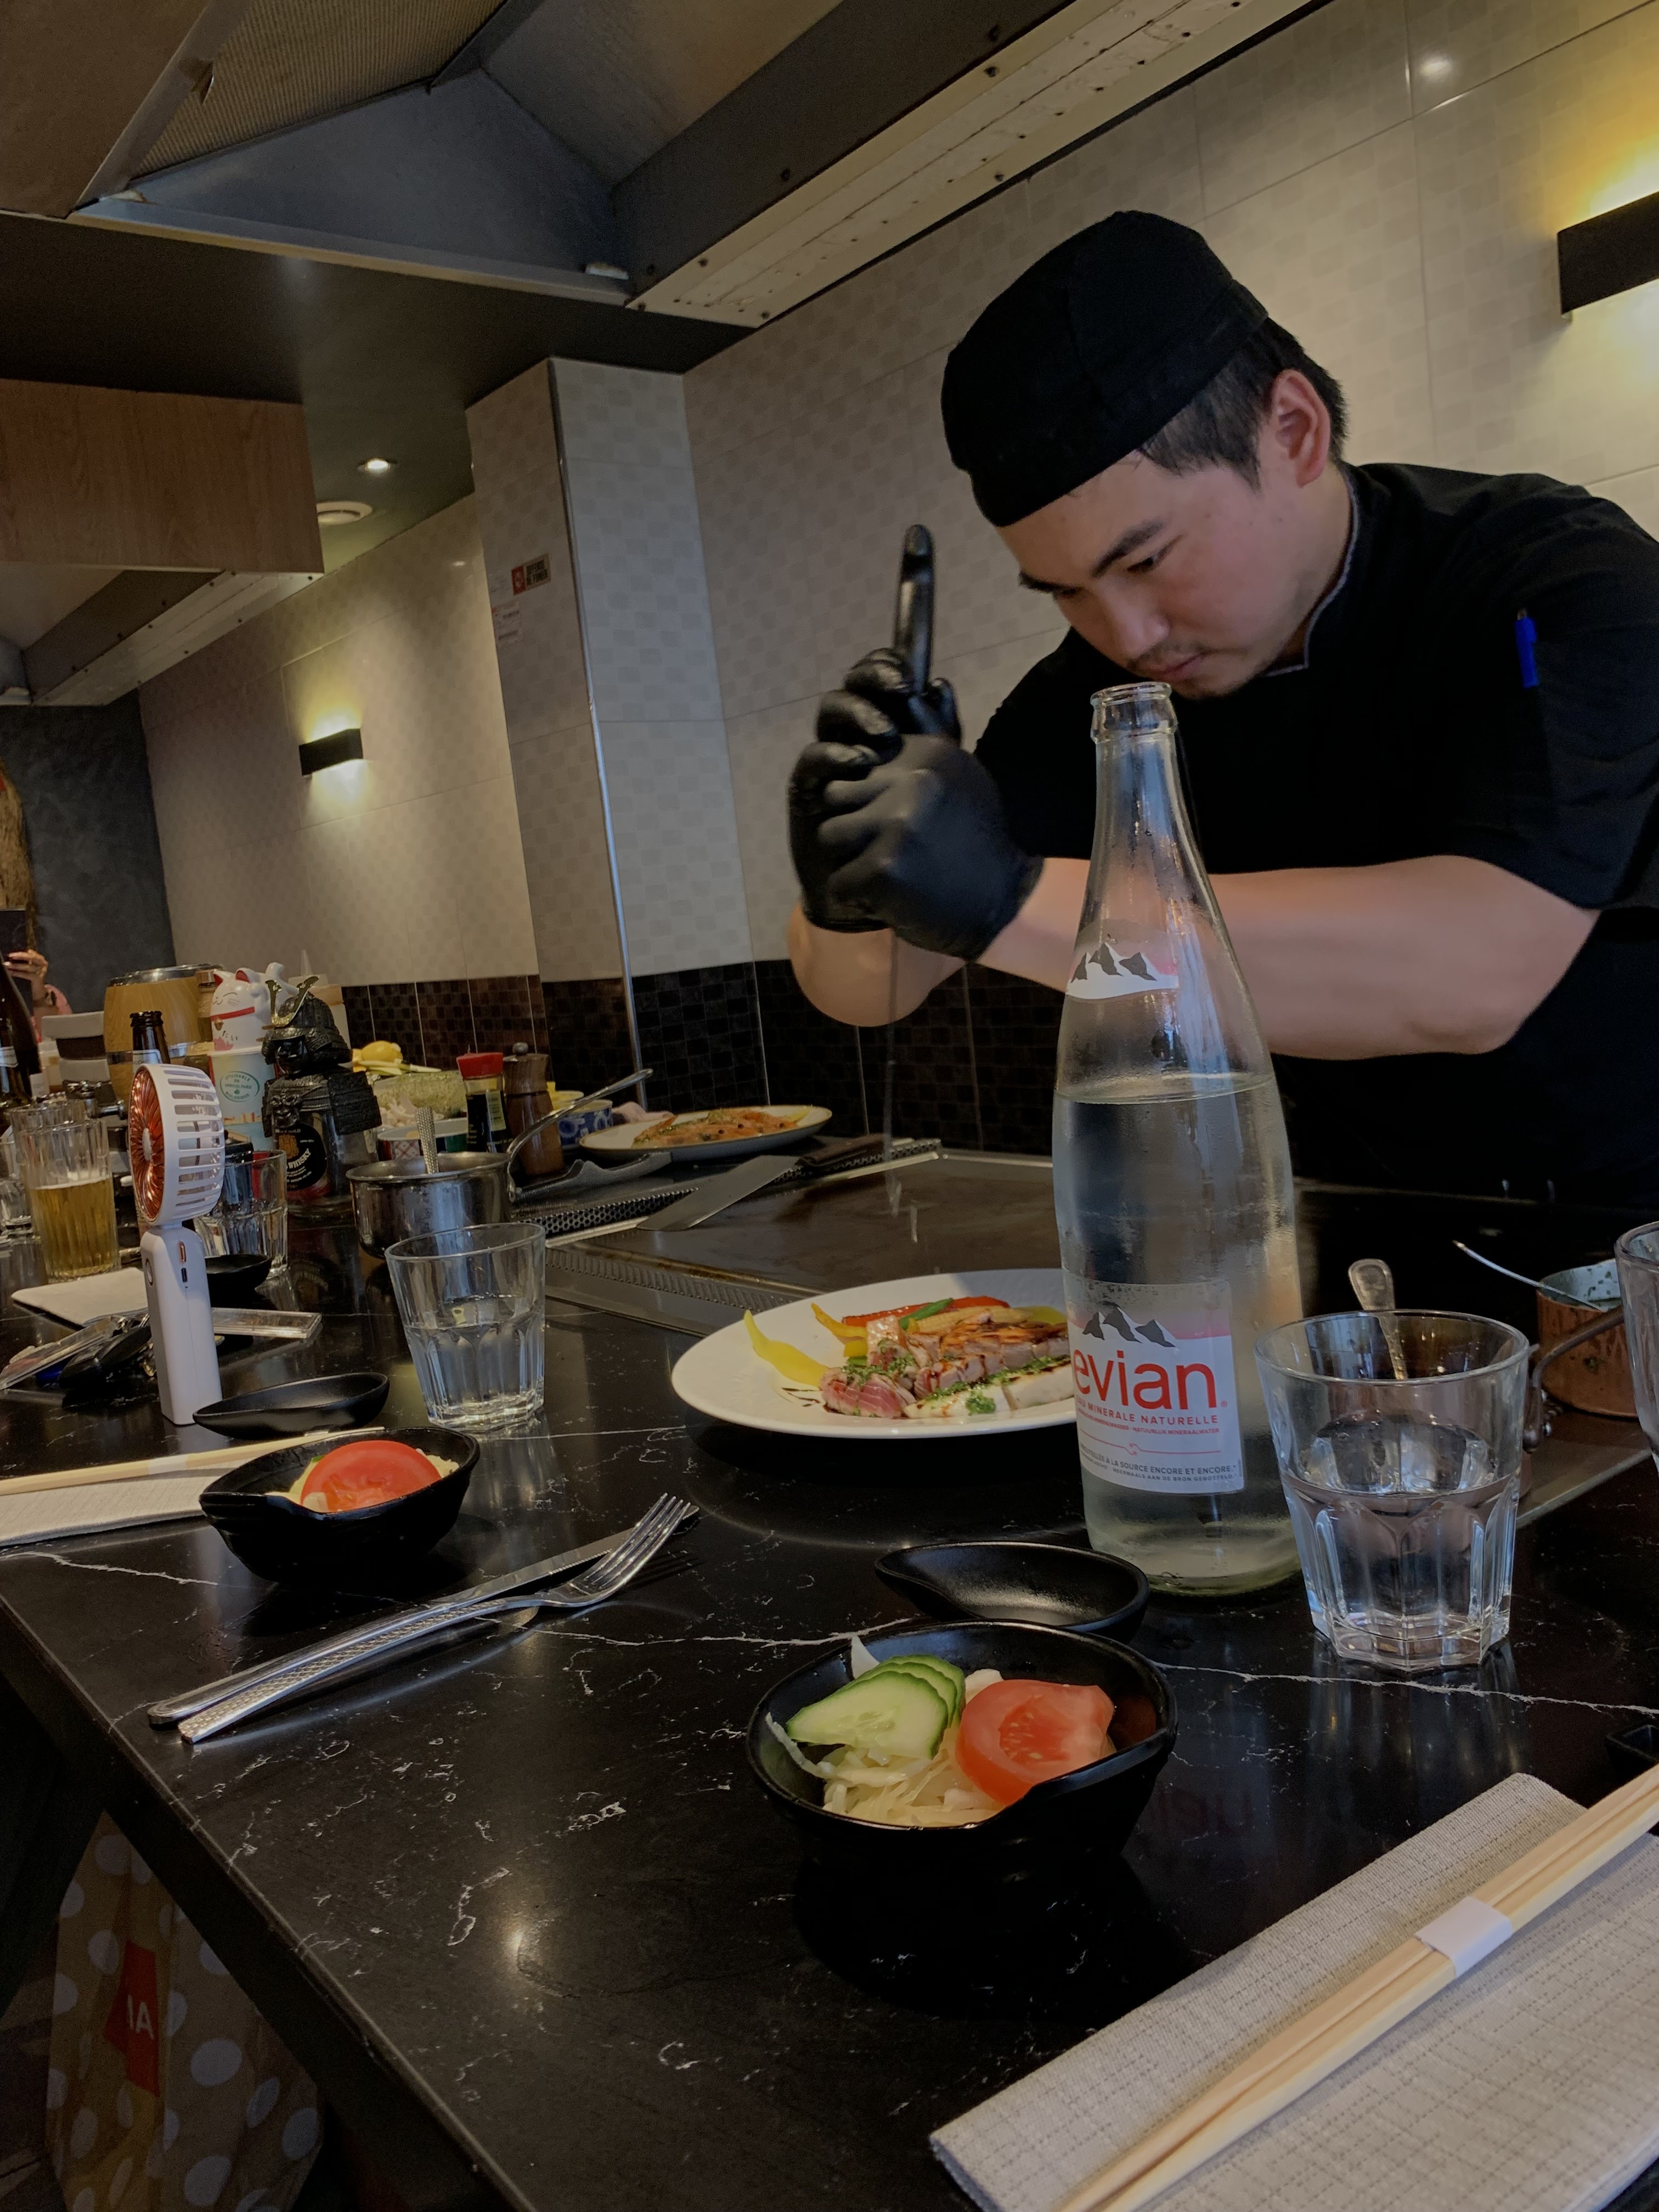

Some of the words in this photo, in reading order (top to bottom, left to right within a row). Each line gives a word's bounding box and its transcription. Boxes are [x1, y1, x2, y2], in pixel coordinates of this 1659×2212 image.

[288, 1148, 312, 1169] WHISKY
[1073, 1349, 1217, 1410] evian
[1141, 1414, 1218, 1425] NATURELLE
[1120, 1462, 1149, 1472] SOURCE
[1150, 1466, 1183, 1475] ENCORE
